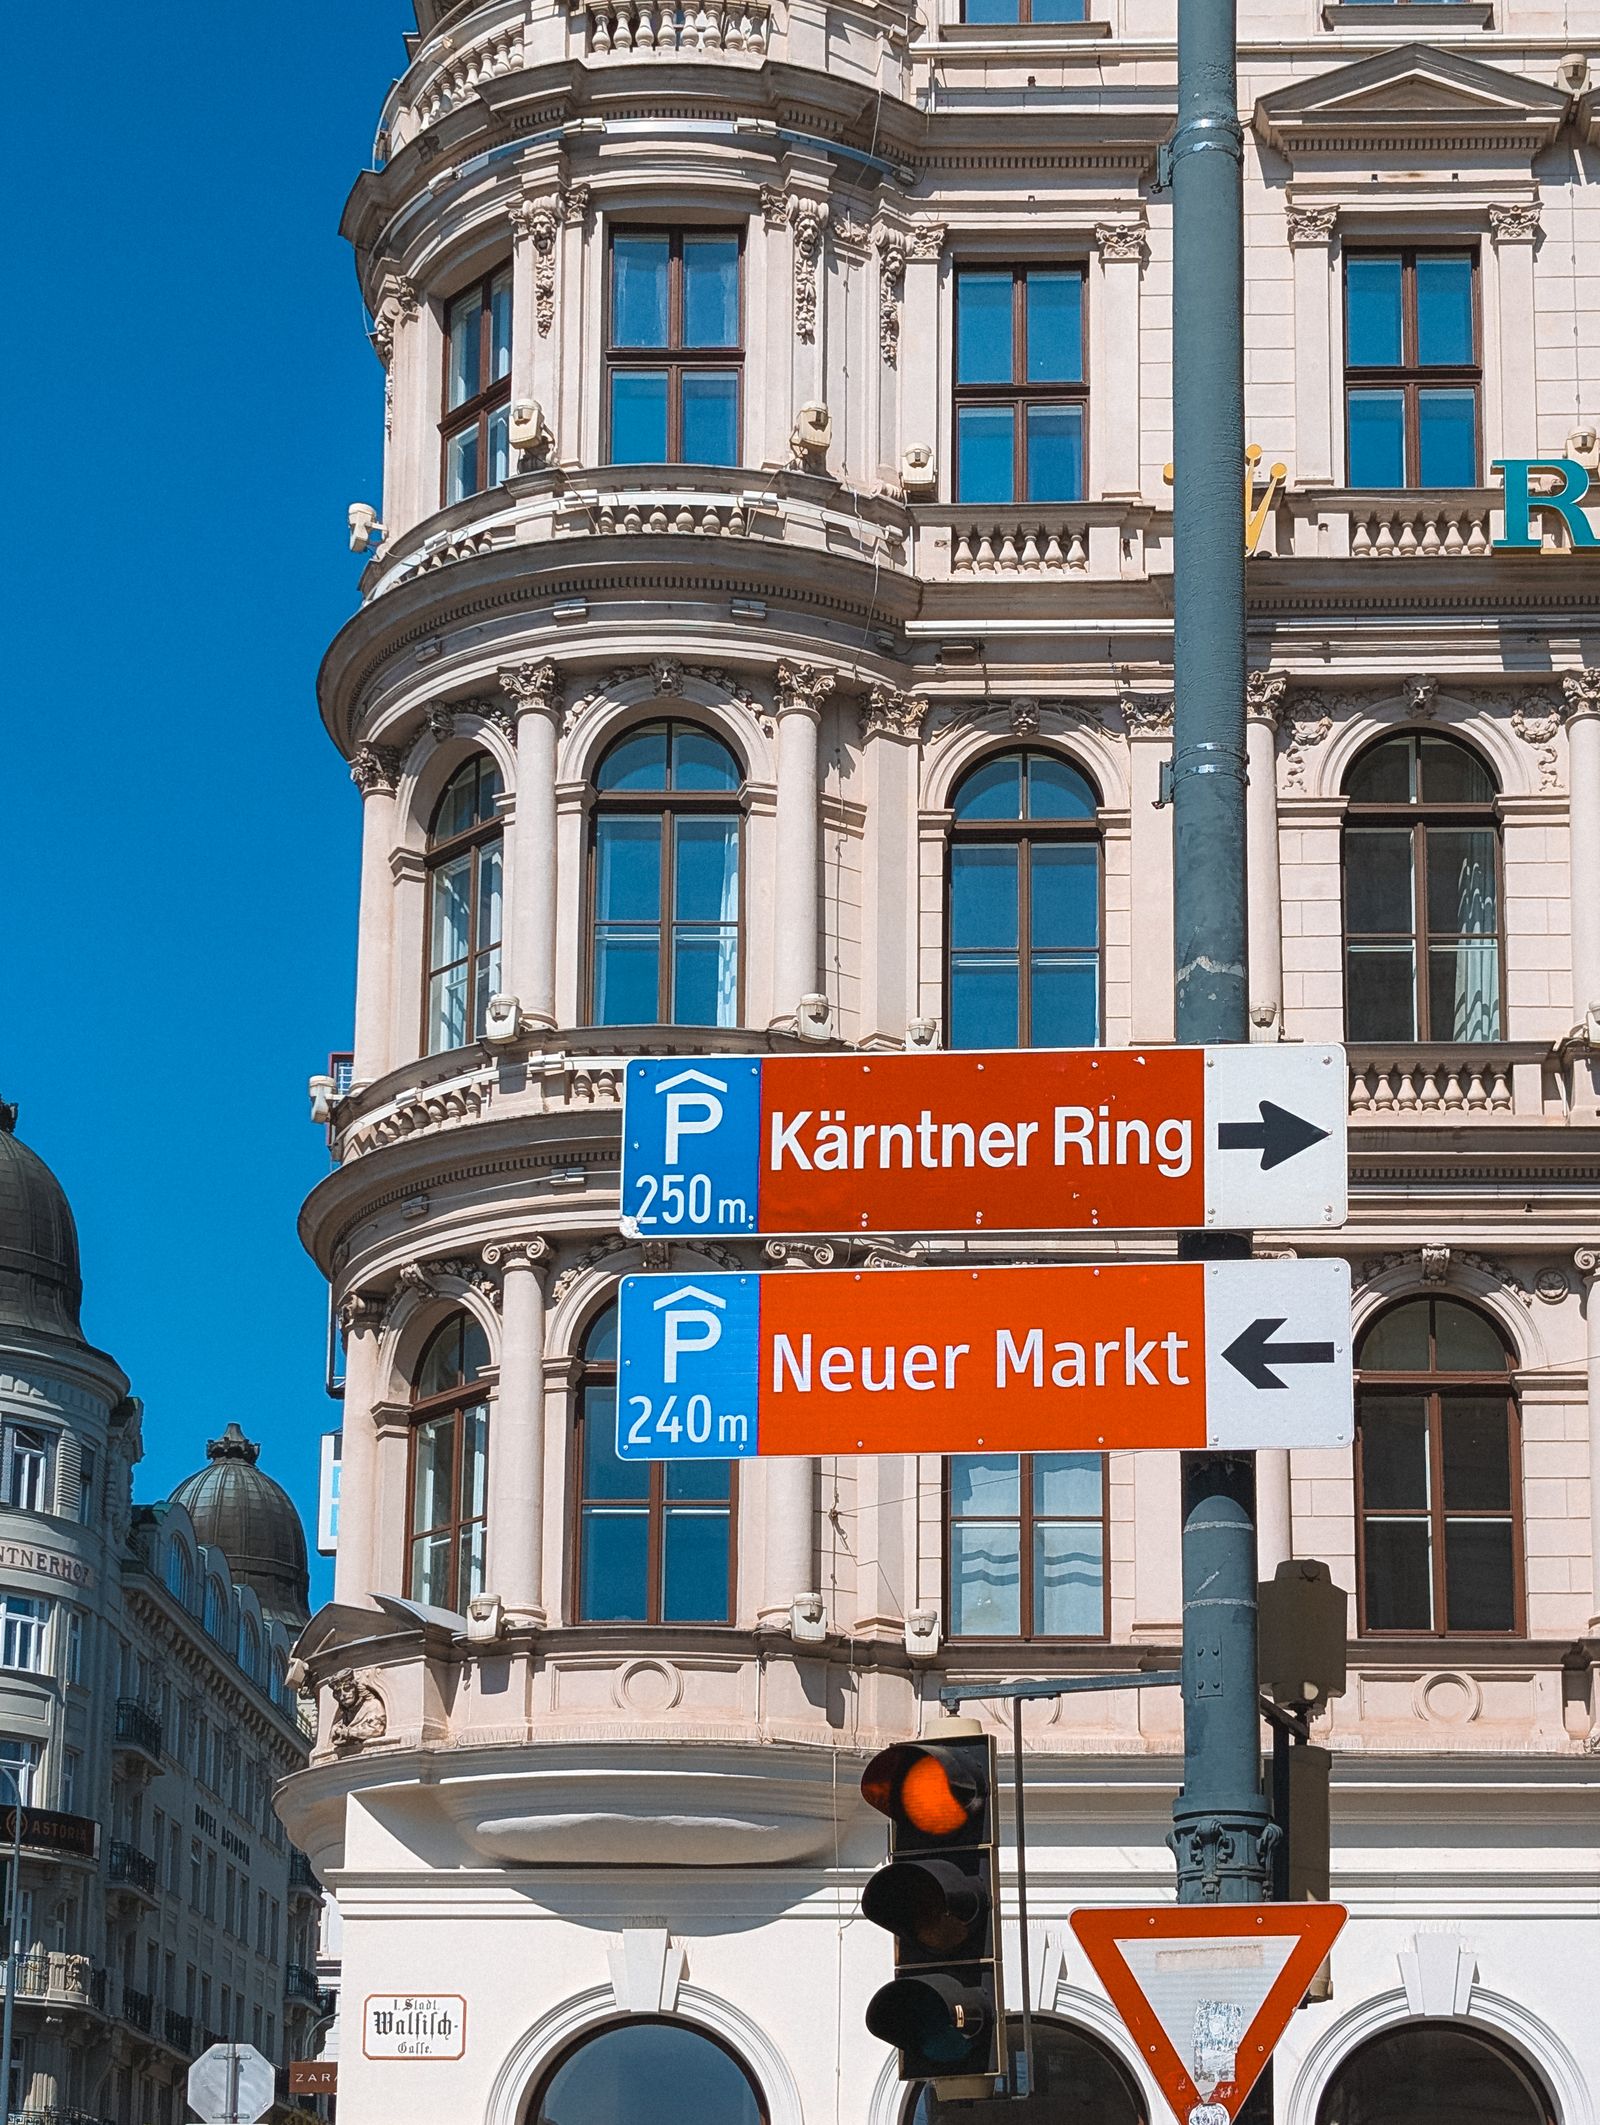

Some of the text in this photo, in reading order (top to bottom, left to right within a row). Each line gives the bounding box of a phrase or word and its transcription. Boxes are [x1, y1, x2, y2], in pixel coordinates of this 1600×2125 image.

[1491, 459, 1600, 548] R
[665, 1093, 723, 1165] P
[770, 1105, 1193, 1178] Kärntner Ring
[663, 1310, 722, 1384] P
[773, 1327, 1191, 1393] Neuer Markt
[32, 1820, 87, 1841] ASTORIA
